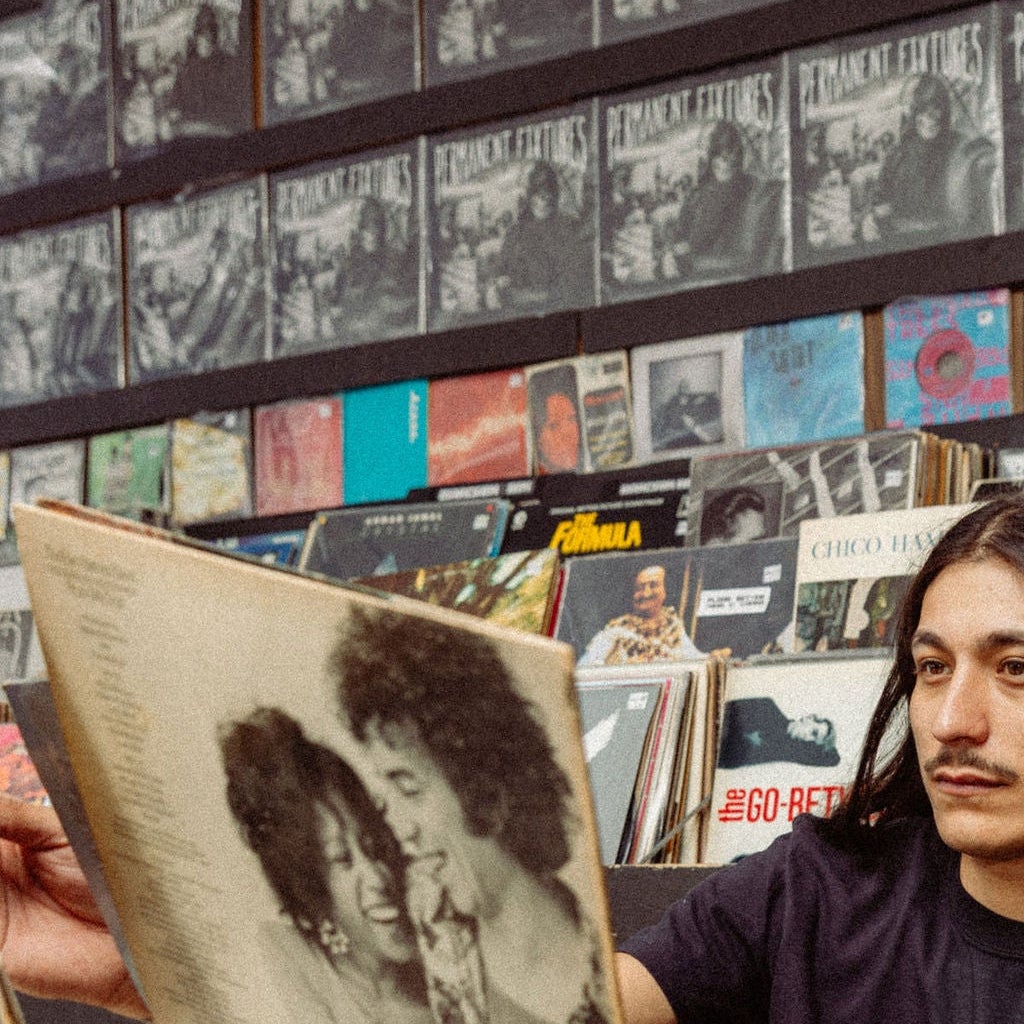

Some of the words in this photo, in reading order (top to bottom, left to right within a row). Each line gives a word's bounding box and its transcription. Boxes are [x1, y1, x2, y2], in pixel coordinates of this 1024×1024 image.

[799, 42, 893, 128] PERMANENT
[898, 22, 983, 86] FIXTURES
[433, 129, 512, 207] PERMANENT
[515, 115, 588, 173] FIXTURES
[607, 89, 692, 171] PERMANENT
[696, 72, 773, 131] FIXTURES
[811, 536, 881, 560] CHICO
[718, 788, 747, 823] the
